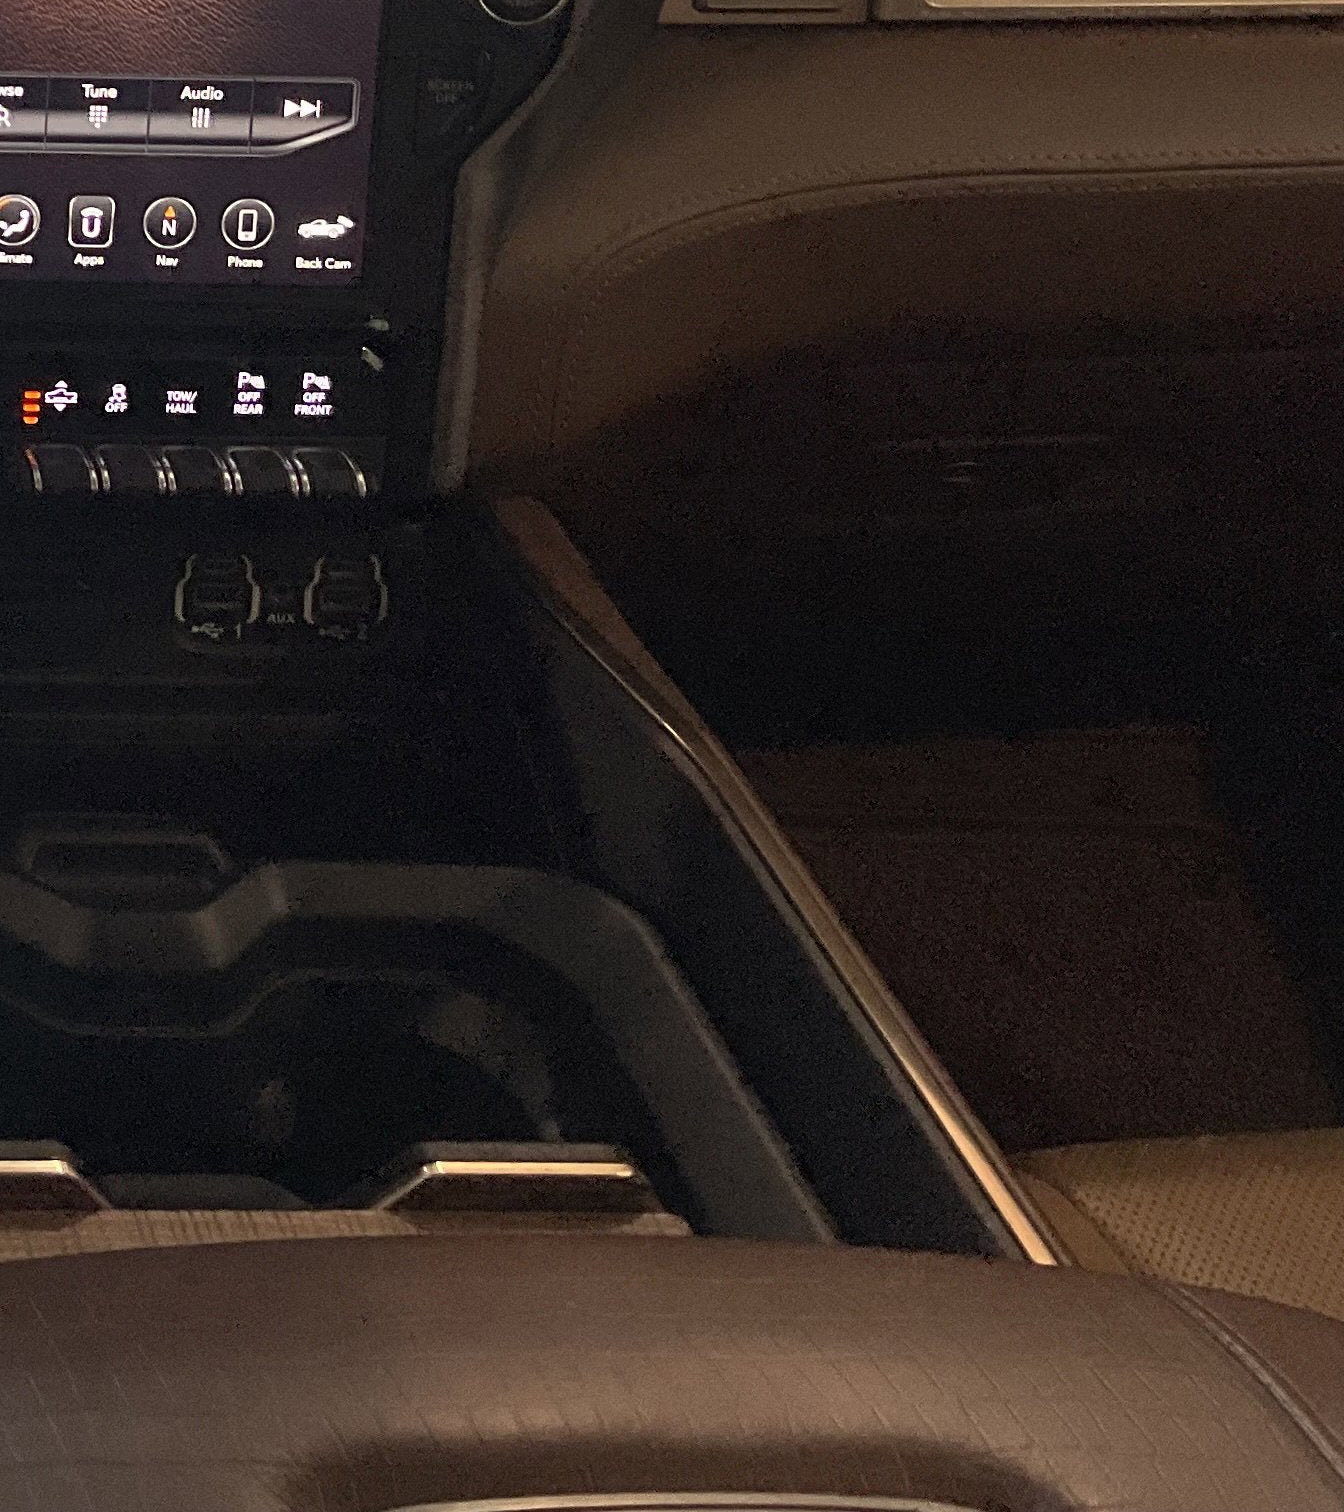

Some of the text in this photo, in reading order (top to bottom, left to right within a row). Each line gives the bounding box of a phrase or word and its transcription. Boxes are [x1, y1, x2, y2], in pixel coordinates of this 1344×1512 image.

[81, 83, 118, 99] Tune
[180, 85, 224, 101] Audio
[73, 252, 105, 267] Apps
[155, 254, 179, 268] Nav
[227, 255, 264, 269] Phone
[295, 256, 352, 270] Back Cam
[237, 392, 262, 403] OFF
[302, 392, 327, 403] OFF
[104, 402, 129, 414] OFF
[165, 402, 197, 414] HAUL
[233, 403, 264, 416] REAR
[294, 403, 333, 416] FRONT
